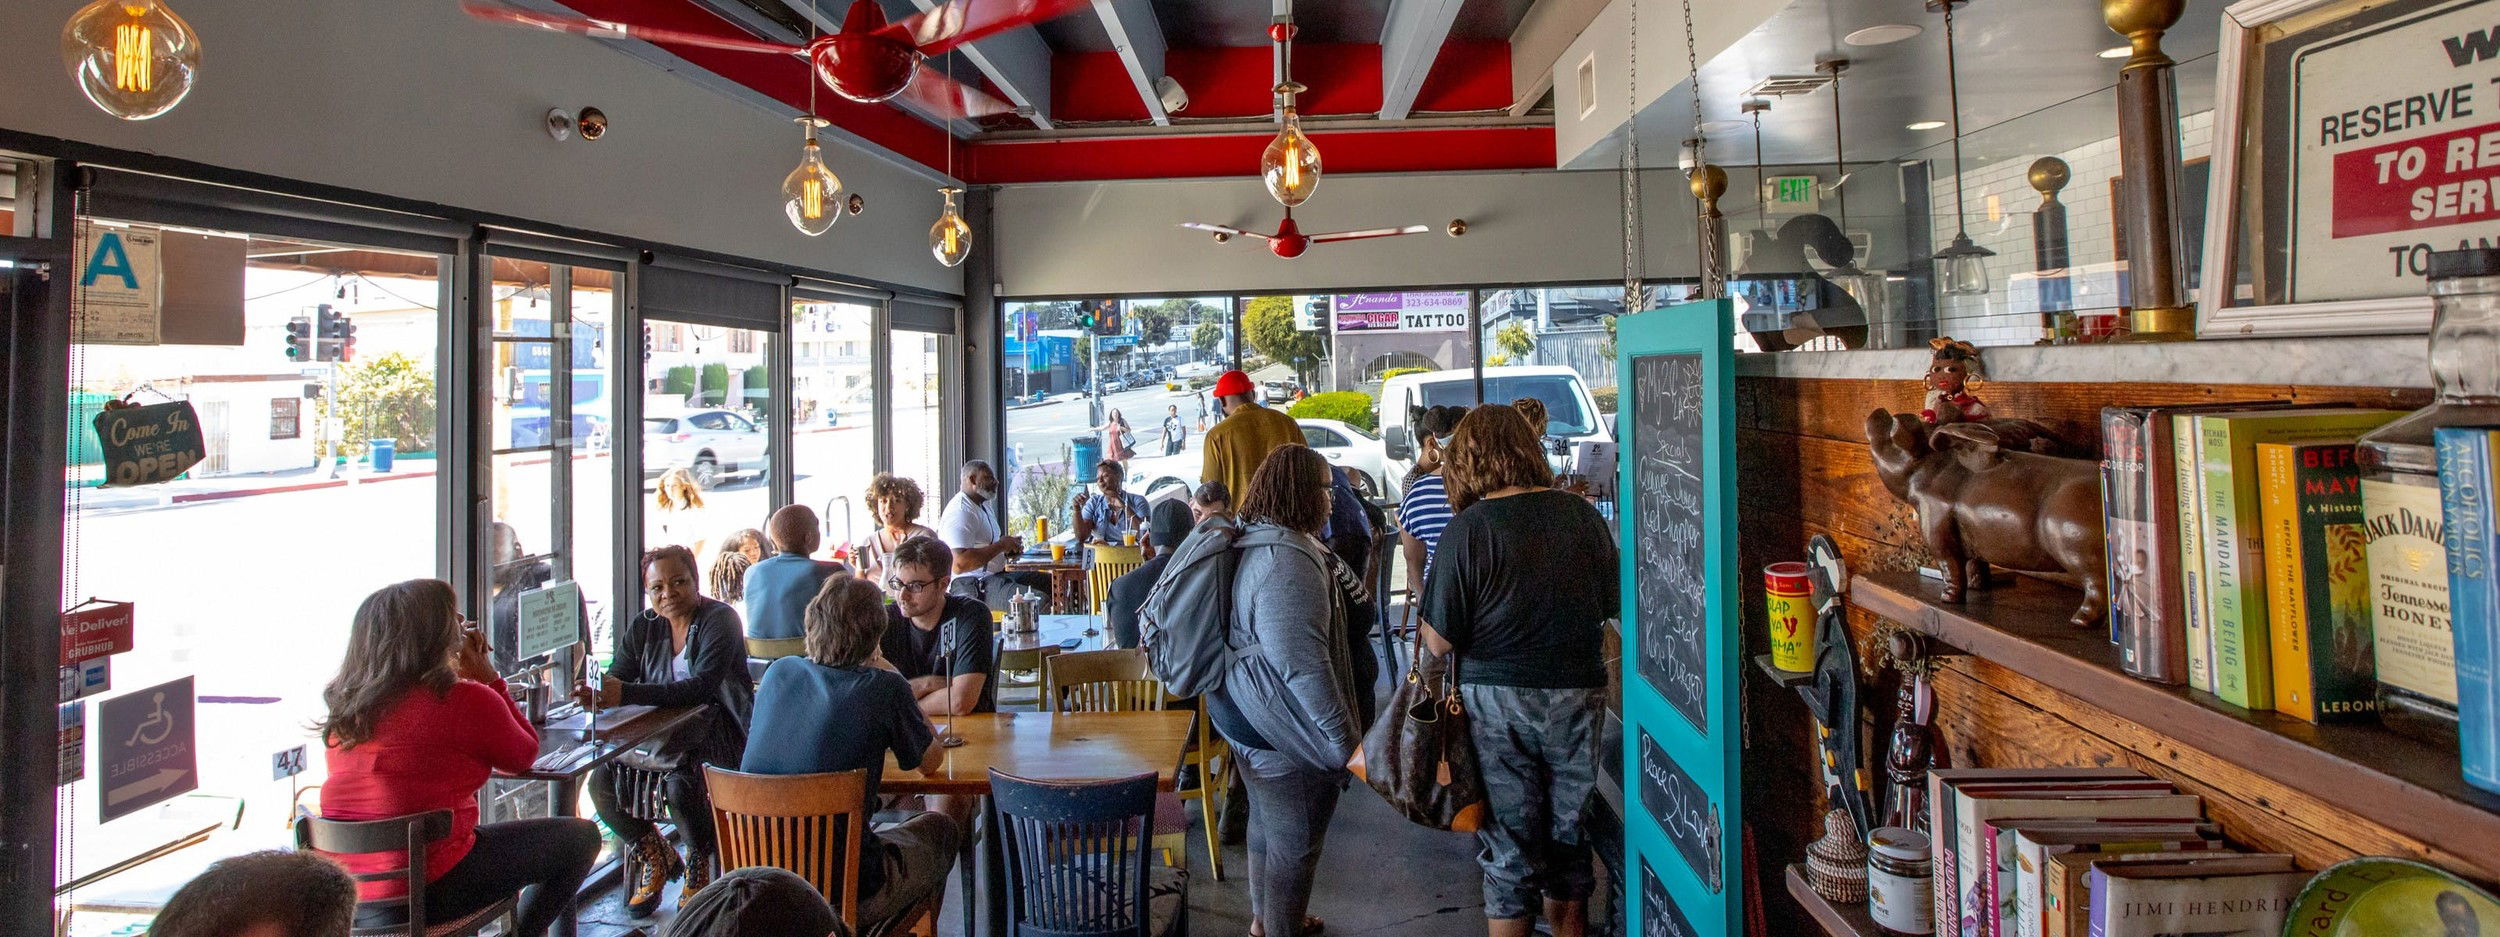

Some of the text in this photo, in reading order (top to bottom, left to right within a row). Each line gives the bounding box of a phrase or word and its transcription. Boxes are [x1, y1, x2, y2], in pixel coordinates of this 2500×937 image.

[2320, 83, 2473, 147] RESERVE
[2375, 146, 2427, 185] TO
[1780, 178, 1809, 202] EXIT
[79, 232, 140, 289] A
[2389, 243, 2432, 277] TO
[1406, 298, 1463, 307] 323-634-0869
[1367, 313, 1397, 323] CIGAR
[1405, 314, 1465, 328] TATTOO
[111, 411, 190, 448] Come In
[2204, 428, 2227, 439] RICHARD
[134, 440, 171, 457] WE'RE
[1554, 439, 1568, 452] 34
[1656, 430, 1692, 464] Specials
[2178, 437, 2188, 456] The
[2208, 438, 2224, 447] MOSS
[117, 449, 197, 484] OPEN
[2125, 462, 2145, 472] FOR
[2303, 449, 2360, 469] BEF
[2180, 467, 2195, 508] Healing
[2304, 475, 2359, 496] MAY
[2306, 503, 2363, 514] A History
[2438, 440, 2464, 576] ANONYMOUS
[2457, 442, 2485, 579] ALCOHOLICS
[2183, 511, 2196, 556] Chakras
[2364, 513, 2400, 545] JACK
[2215, 490, 2238, 667] THE MANDALA OF BEING
[2283, 519, 2299, 652] BEFORE THE MAYFLOWER
[2380, 574, 2419, 586] ORIGINAL
[79, 613, 129, 634] Deliver!
[1771, 621, 1782, 633] YA
[68, 640, 114, 659] GRUBHUB
[588, 658, 600, 681] 32
[277, 746, 304, 770] 47
[1934, 856, 1944, 894] italian
[2123, 902, 2173, 918] JIMI
